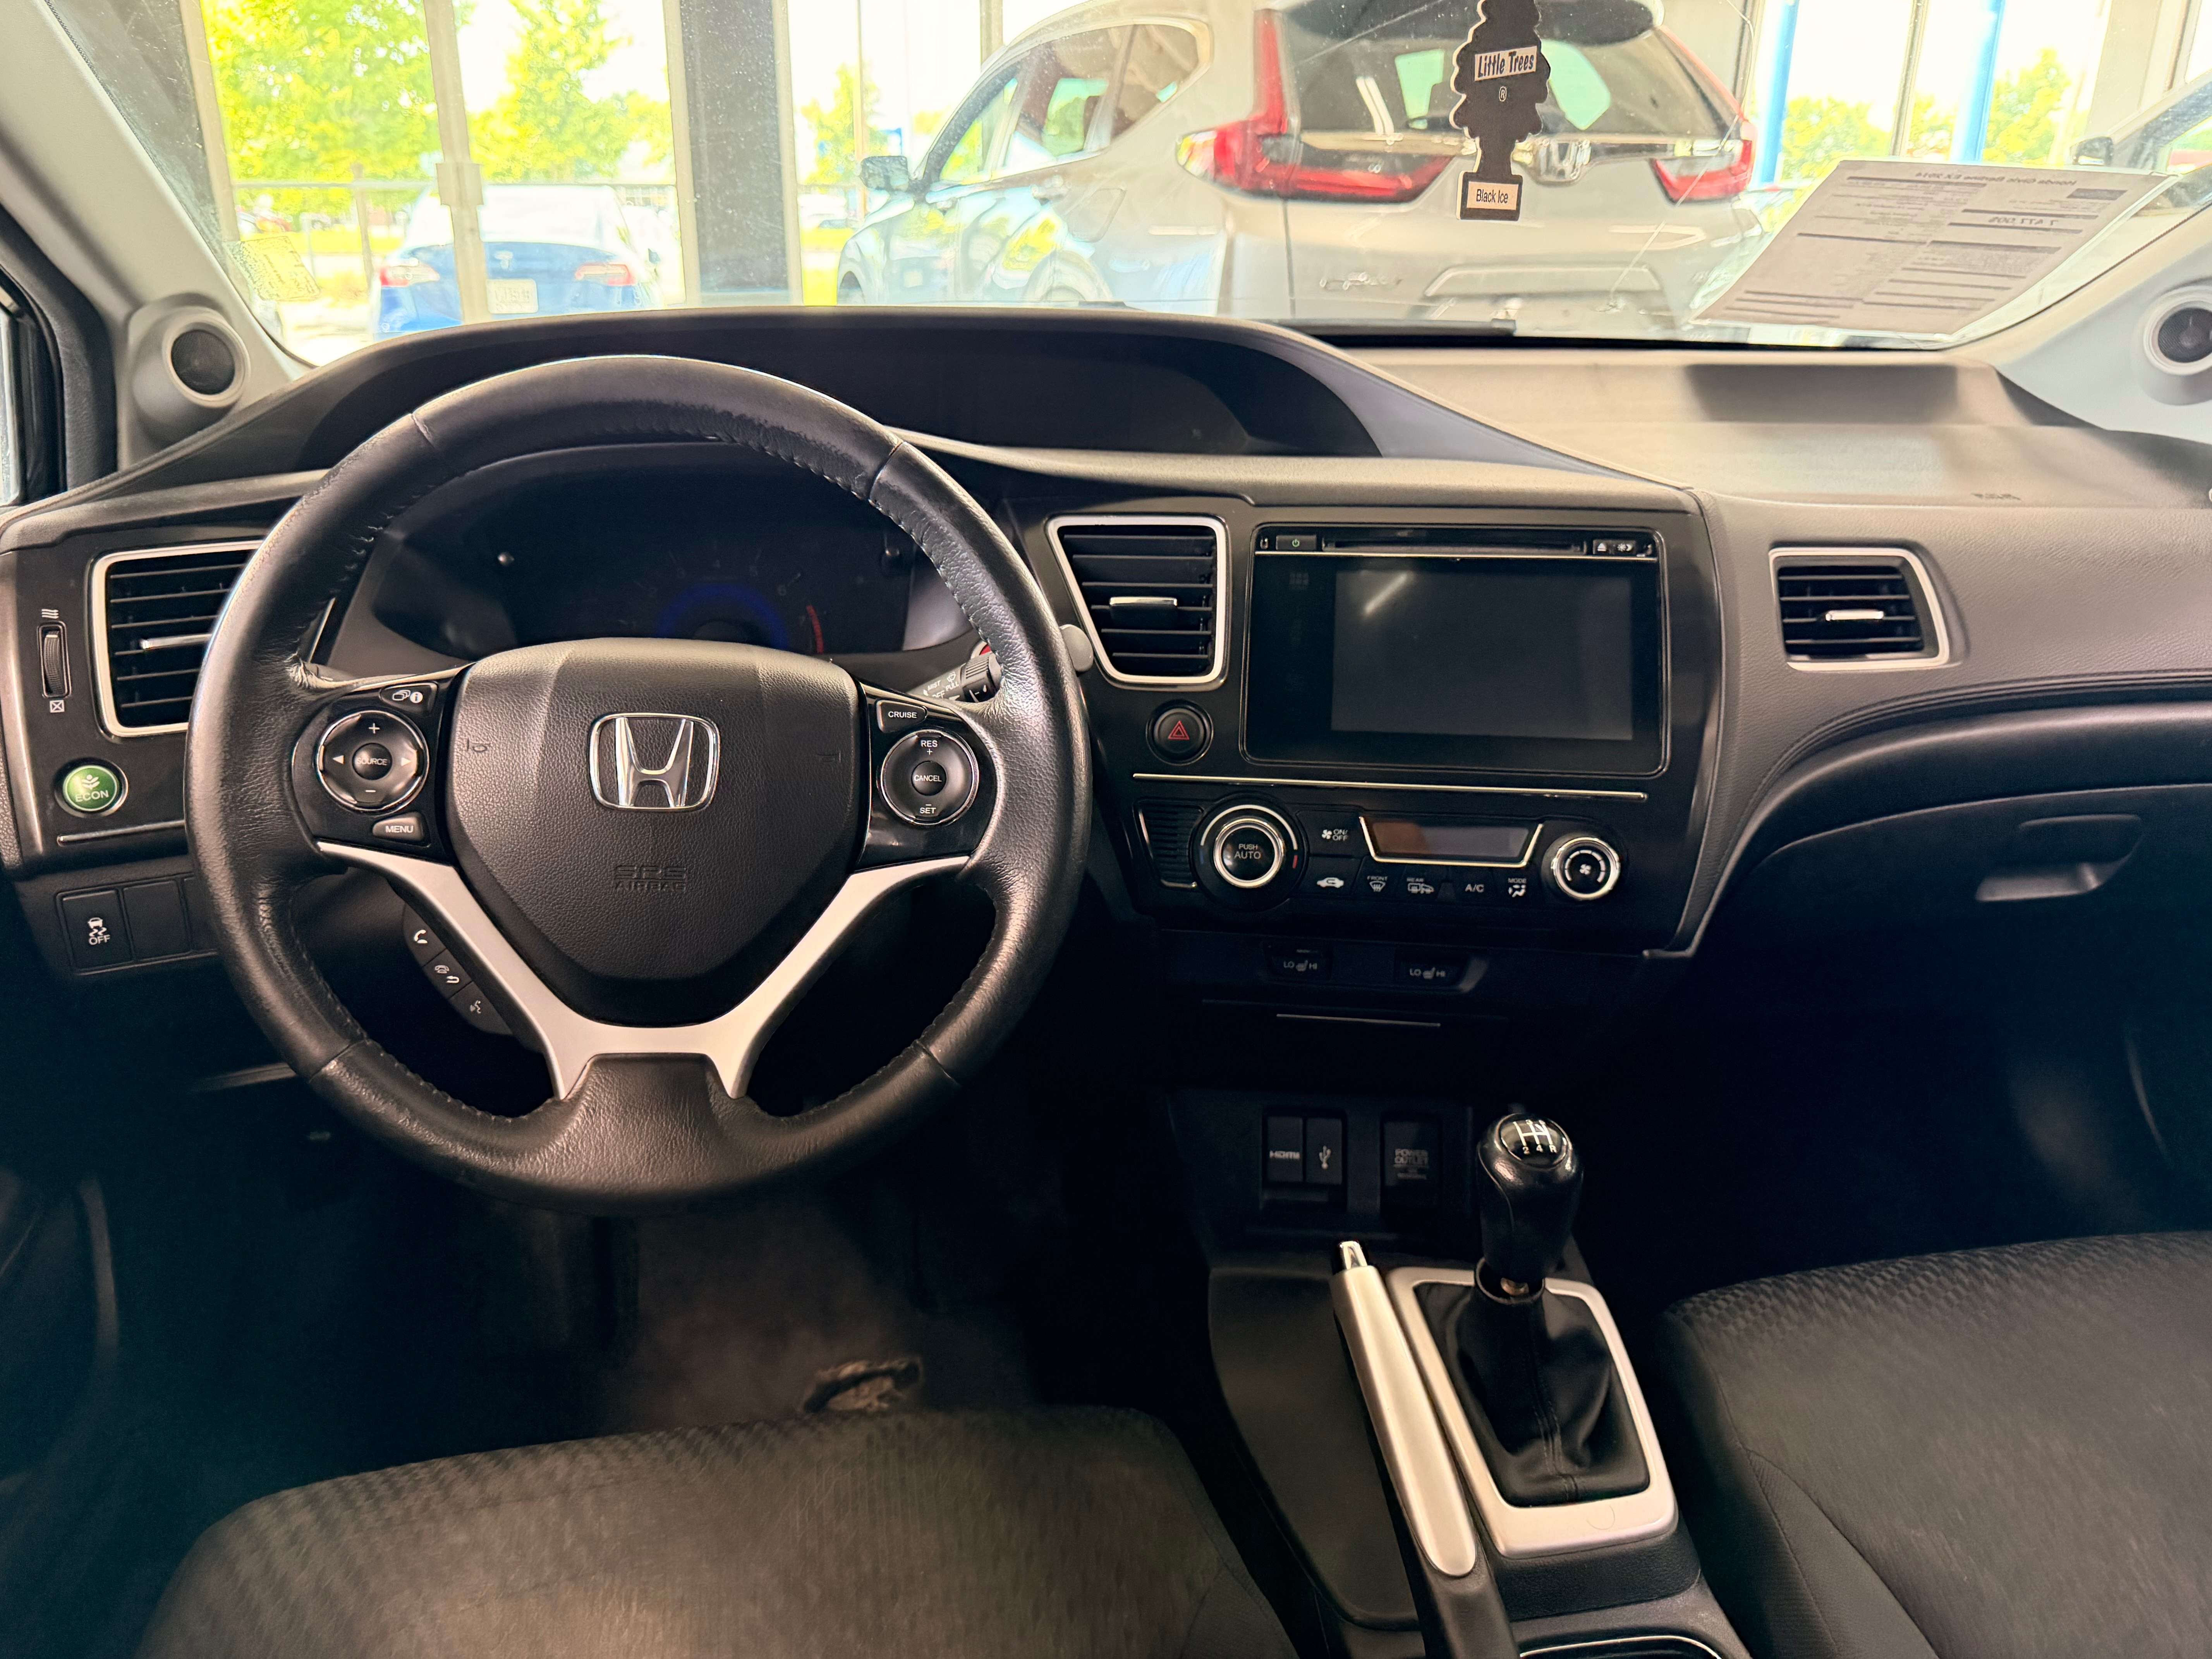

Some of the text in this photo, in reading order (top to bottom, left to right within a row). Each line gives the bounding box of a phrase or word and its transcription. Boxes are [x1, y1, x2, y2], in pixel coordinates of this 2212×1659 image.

[1477, 50, 1534, 77] Little Trees
[1476, 189, 1508, 204] Black Ice
[945, 681, 959, 691] PULL
[888, 710, 917, 719] CRUISE
[357, 757, 388, 766] SOURCE
[914, 774, 942, 782] CANCEL
[75, 790, 109, 803] ECON
[919, 807, 936, 815] SET
[385, 825, 414, 834] MENU
[1234, 852, 1262, 860] AUTO
[614, 865, 687, 881] SRS
[614, 882, 687, 892] AIRBAG
[1465, 884, 1484, 893] A/C
[89, 933, 110, 946] OFF
[1283, 960, 1295, 969] LO
[1410, 969, 1422, 977] LO
[1522, 1146, 1529, 1154] 2
[1549, 1145, 1557, 1153] R
